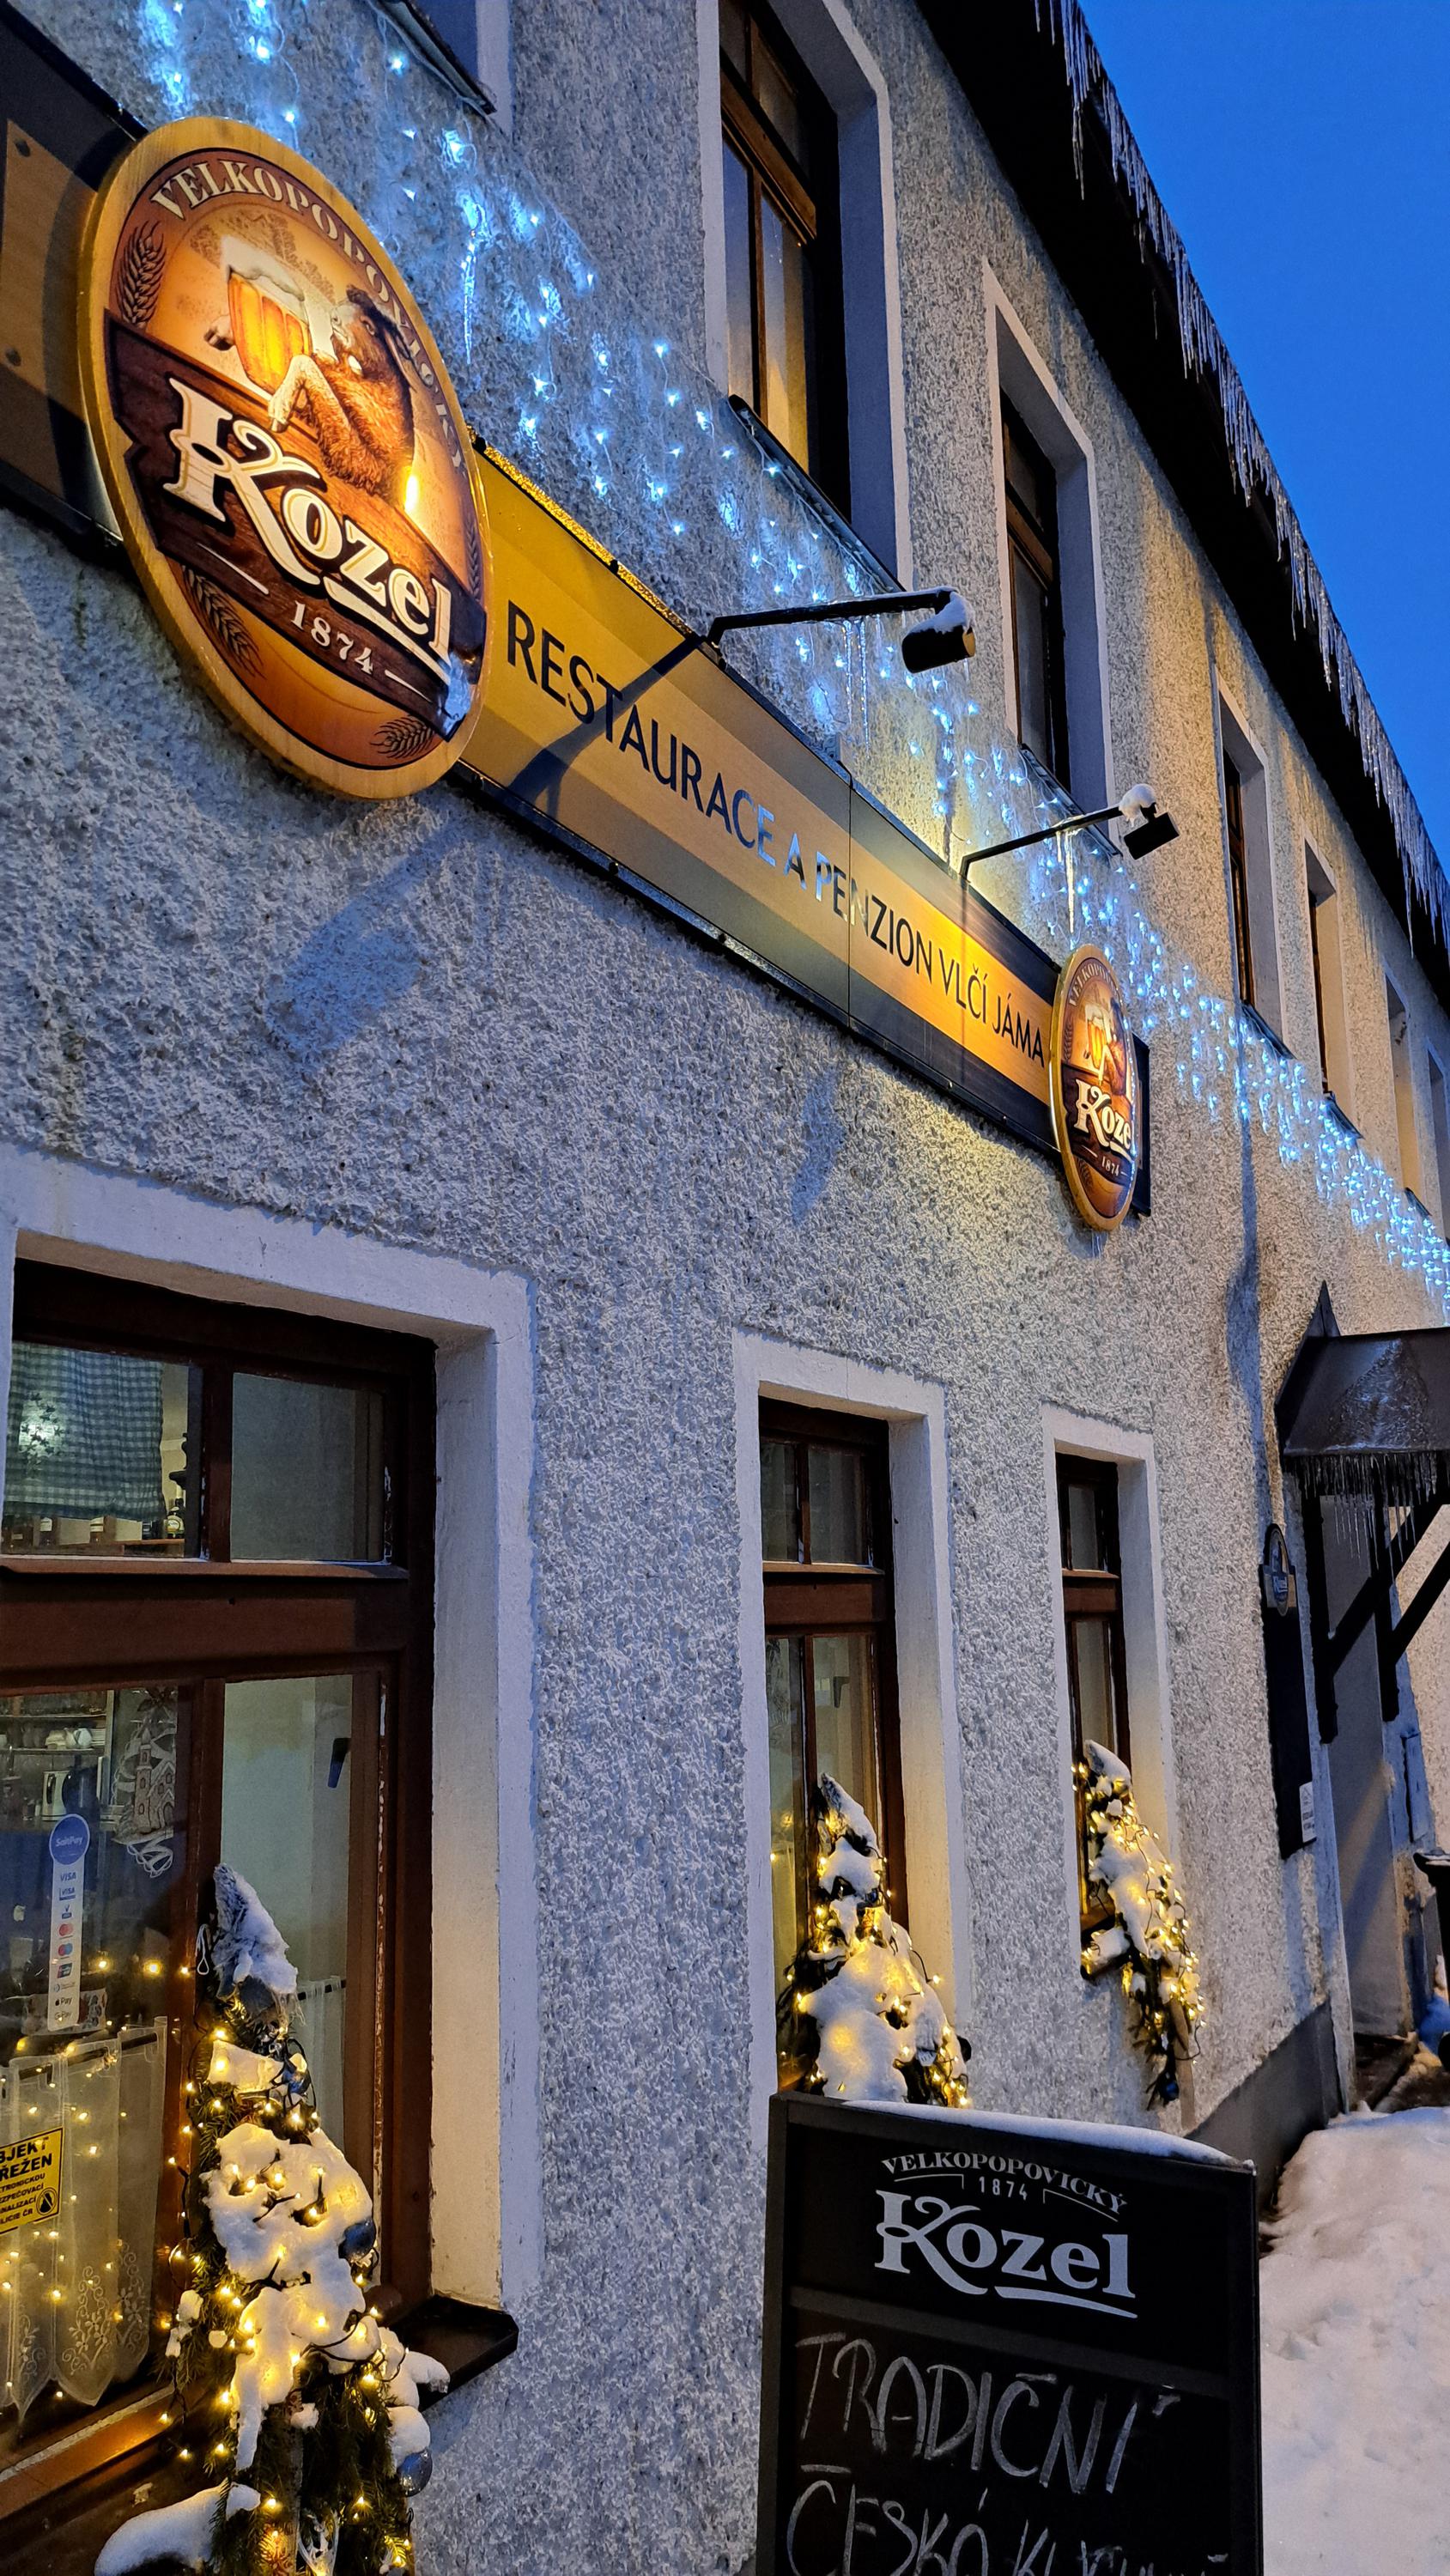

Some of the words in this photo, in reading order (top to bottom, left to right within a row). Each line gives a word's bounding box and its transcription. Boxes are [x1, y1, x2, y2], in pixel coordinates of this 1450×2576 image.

[163, 377, 452, 664] Kozel
[290, 600, 375, 677] 1874
[507, 599, 776, 866] RESTAURACE
[784, 831, 808, 890] A
[815, 850, 933, 985] PENZION
[937, 947, 988, 1022] VLČÍ
[992, 992, 1045, 1069] JÁMA
[1101, 1155, 1119, 1176] 1874
[60, 1872, 76, 1881] VISA
[880, 2151, 1128, 2215] VELKOPOPOVICKÝ
[978, 2176, 1028, 2201] 1874
[874, 2189, 1137, 2300] Kozel
[794, 2332, 1182, 2494] TRADIČNÍ
